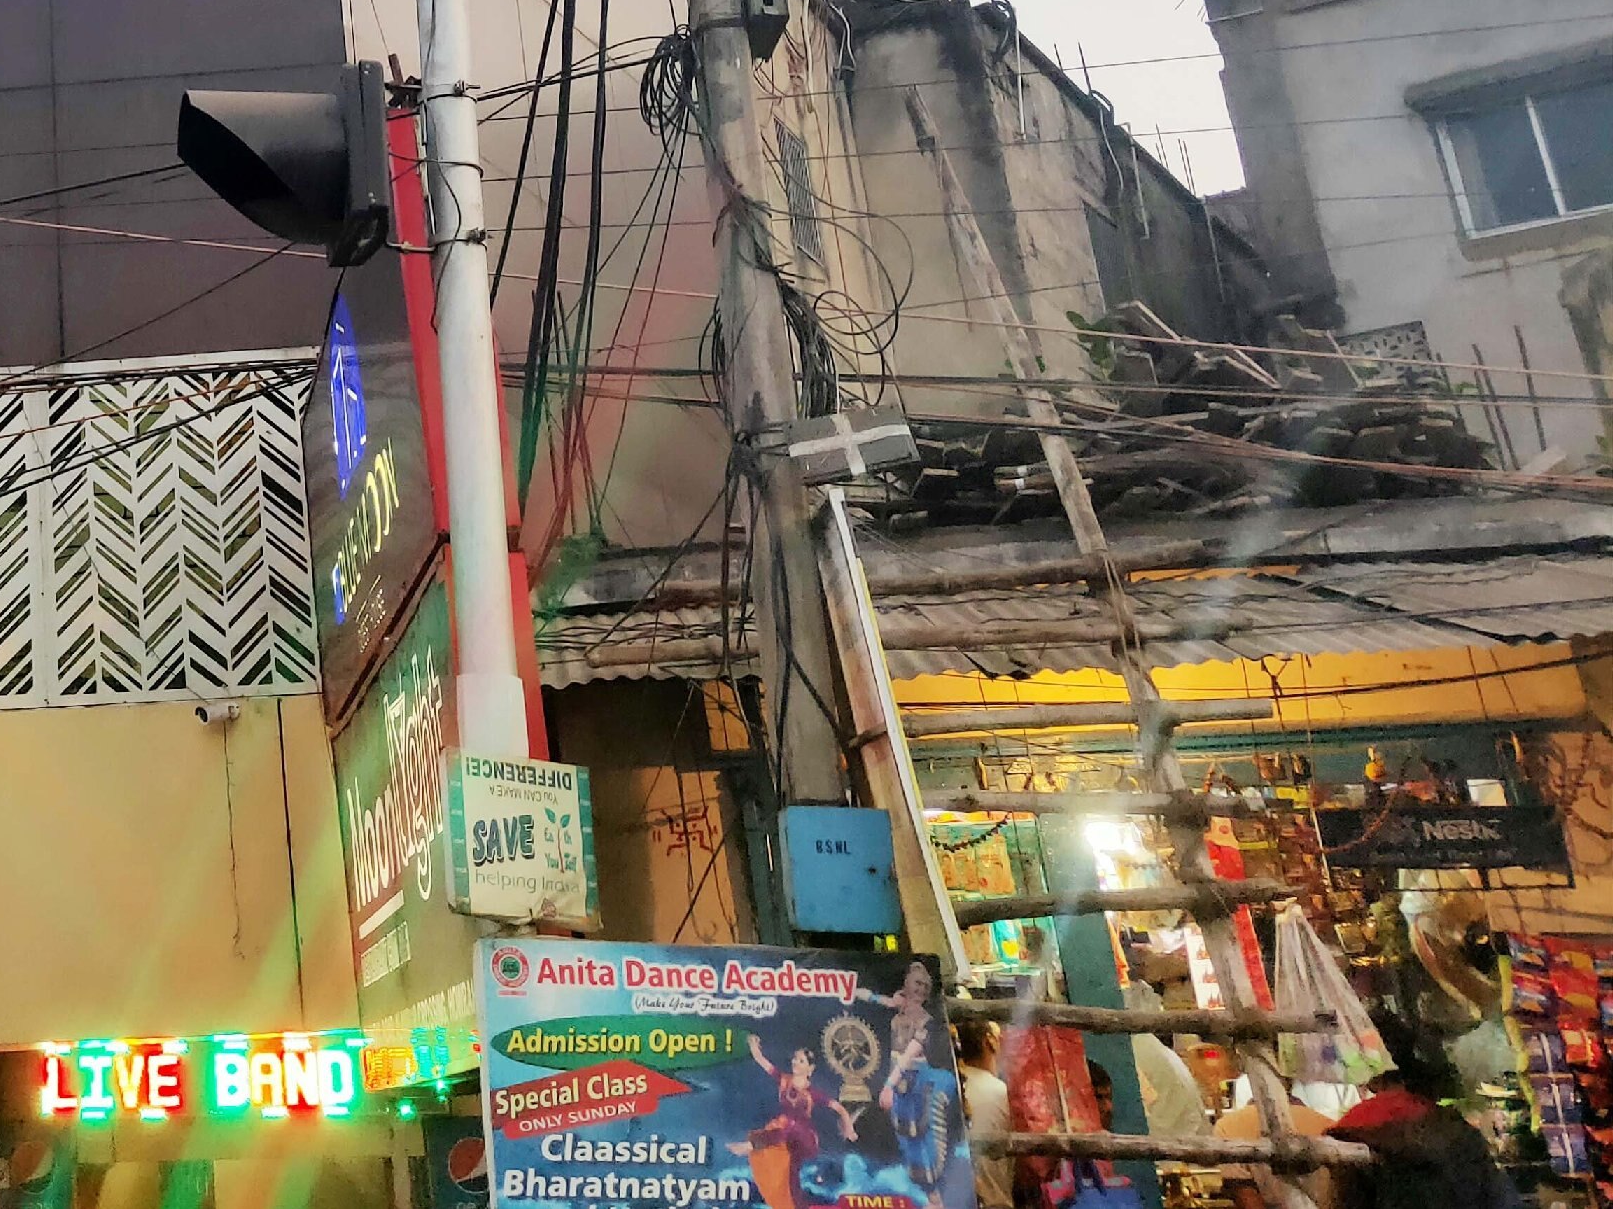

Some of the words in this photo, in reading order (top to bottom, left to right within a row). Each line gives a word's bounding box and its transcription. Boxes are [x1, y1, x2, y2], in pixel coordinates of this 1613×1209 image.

[465, 756, 573, 791] DIFFERENCE!
[472, 814, 535, 867] SAVE
[475, 869, 537, 894] helping
[542, 875, 580, 893] India
[537, 956, 615, 987] Anita
[625, 959, 715, 990] Dance
[724, 963, 857, 1002] Academy
[506, 1028, 641, 1056] Admission
[647, 1028, 717, 1060] Open
[44, 1052, 182, 1112] LIVE
[215, 1051, 355, 1107] BAND
[495, 1075, 580, 1119] Special
[587, 1073, 648, 1100] Class
[518, 1113, 563, 1133] ONLY
[568, 1101, 638, 1124] SUNDAY
[540, 1133, 707, 1164] Claassical
[503, 1168, 751, 1208] Bharatnatyam
[845, 1195, 894, 1208] TIME
